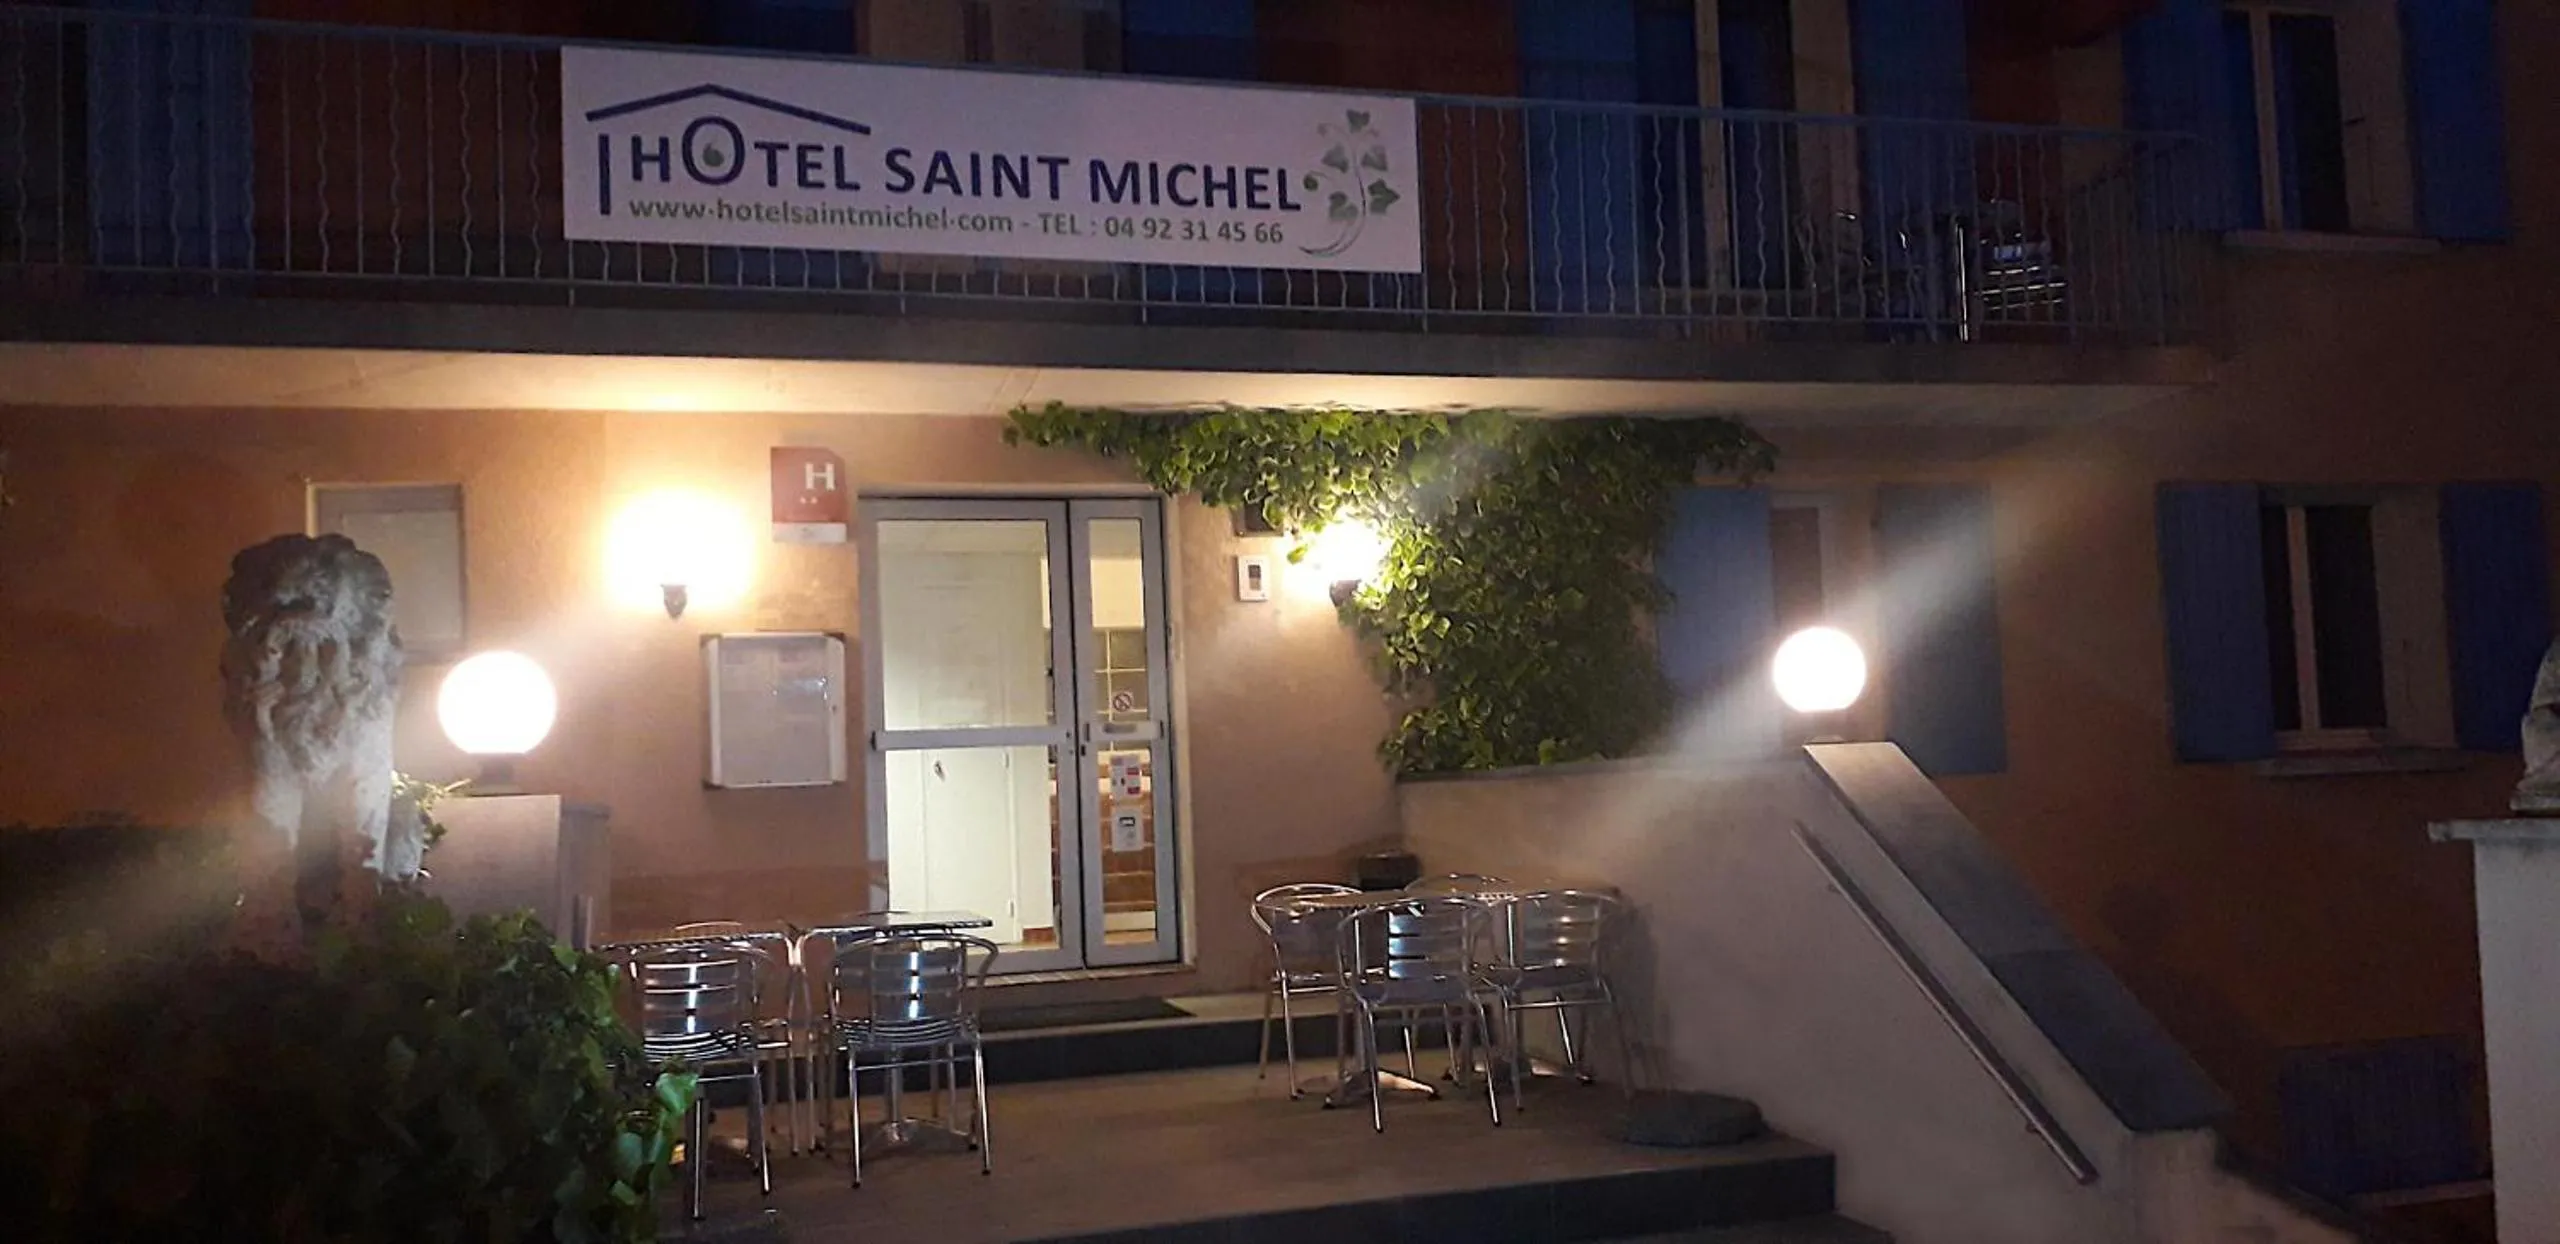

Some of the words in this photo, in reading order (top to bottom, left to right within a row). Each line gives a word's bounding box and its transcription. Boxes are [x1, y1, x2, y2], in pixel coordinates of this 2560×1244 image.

[885, 148, 1069, 200] SAINT
[1089, 159, 1301, 211] MICHEL
[1038, 213, 1081, 236] TEL
[1105, 216, 1137, 238] 04
[1143, 218, 1173, 240] 92
[1181, 219, 1208, 241] 31
[1217, 221, 1246, 242] 45
[1254, 223, 1284, 243] 66
[805, 463, 835, 490] H
